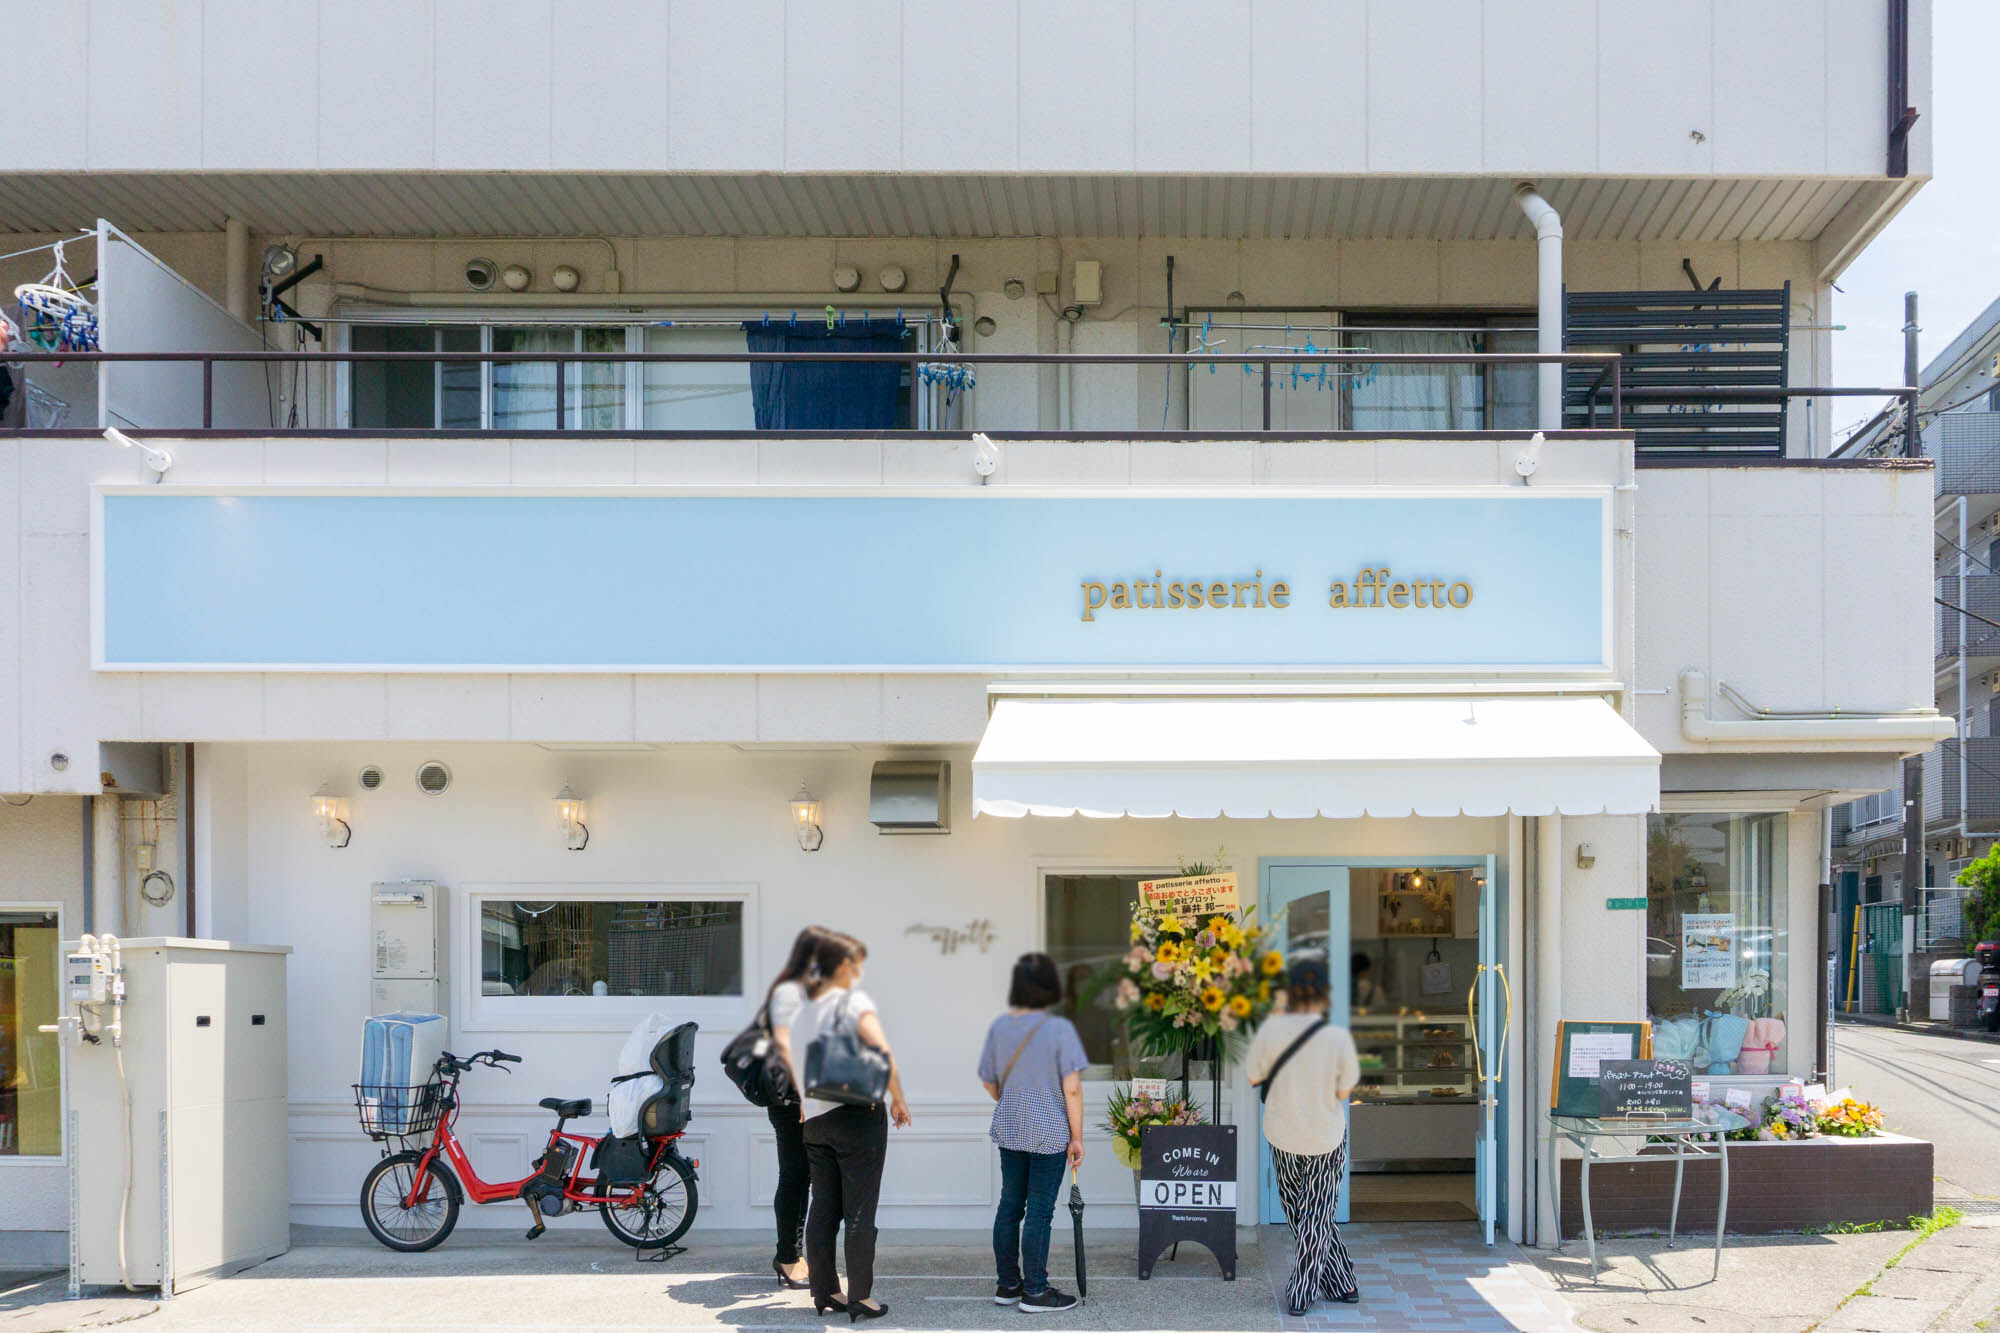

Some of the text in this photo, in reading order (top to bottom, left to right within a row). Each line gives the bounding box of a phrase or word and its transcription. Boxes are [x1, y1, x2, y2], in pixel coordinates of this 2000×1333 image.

[1080, 567, 1474, 622] patisserie affetto
[1155, 879, 1192, 890] patisserie
[1194, 877, 1221, 886] affetto
[1162, 1147, 1220, 1166] COME IN
[1172, 1164, 1209, 1177] We are
[1155, 1182, 1222, 1205] OPEN
